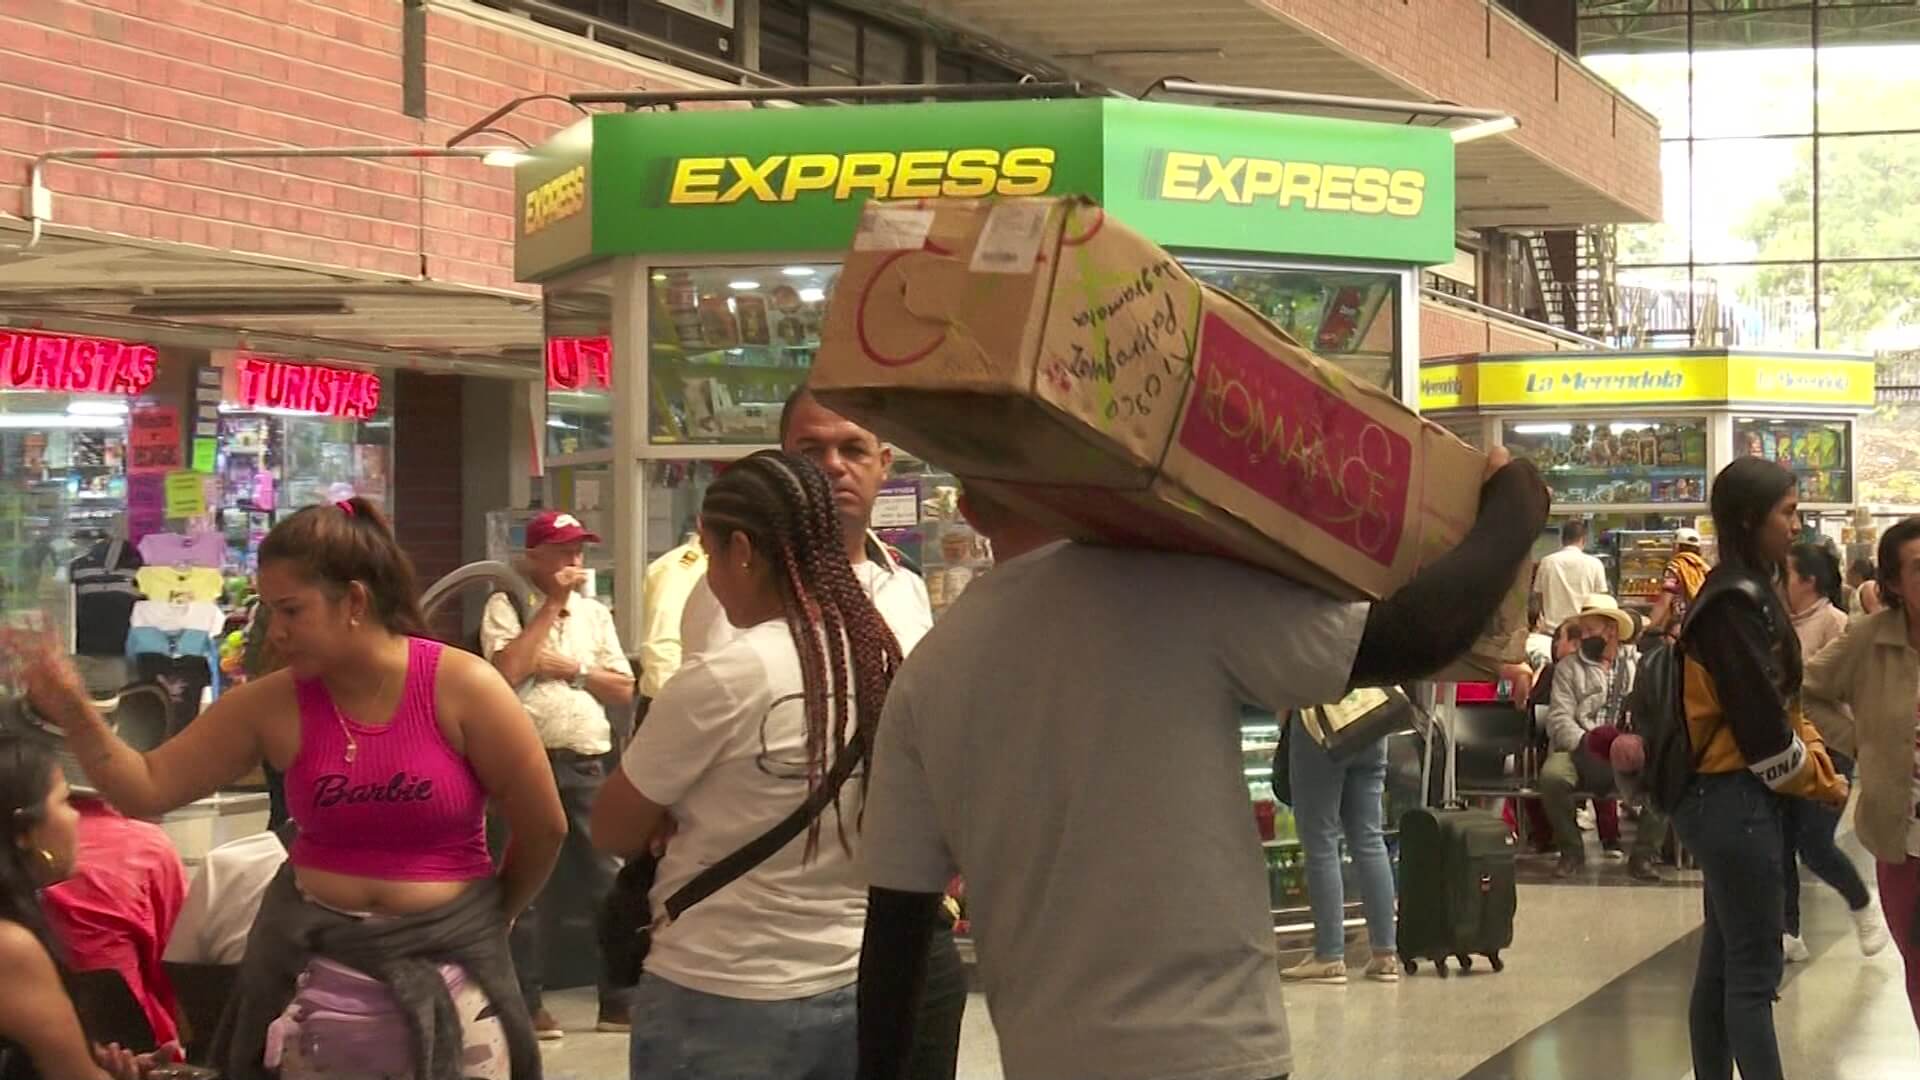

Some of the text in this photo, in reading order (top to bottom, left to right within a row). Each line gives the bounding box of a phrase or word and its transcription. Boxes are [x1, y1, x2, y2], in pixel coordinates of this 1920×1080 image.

[525, 166, 586, 236] EXPRESS
[668, 147, 1056, 204] EXPRESS
[1161, 150, 1426, 217] EXPRESS
[244, 358, 380, 419] TURISTAS
[1526, 373, 1553, 393] La
[313, 772, 433, 808] Barbie
